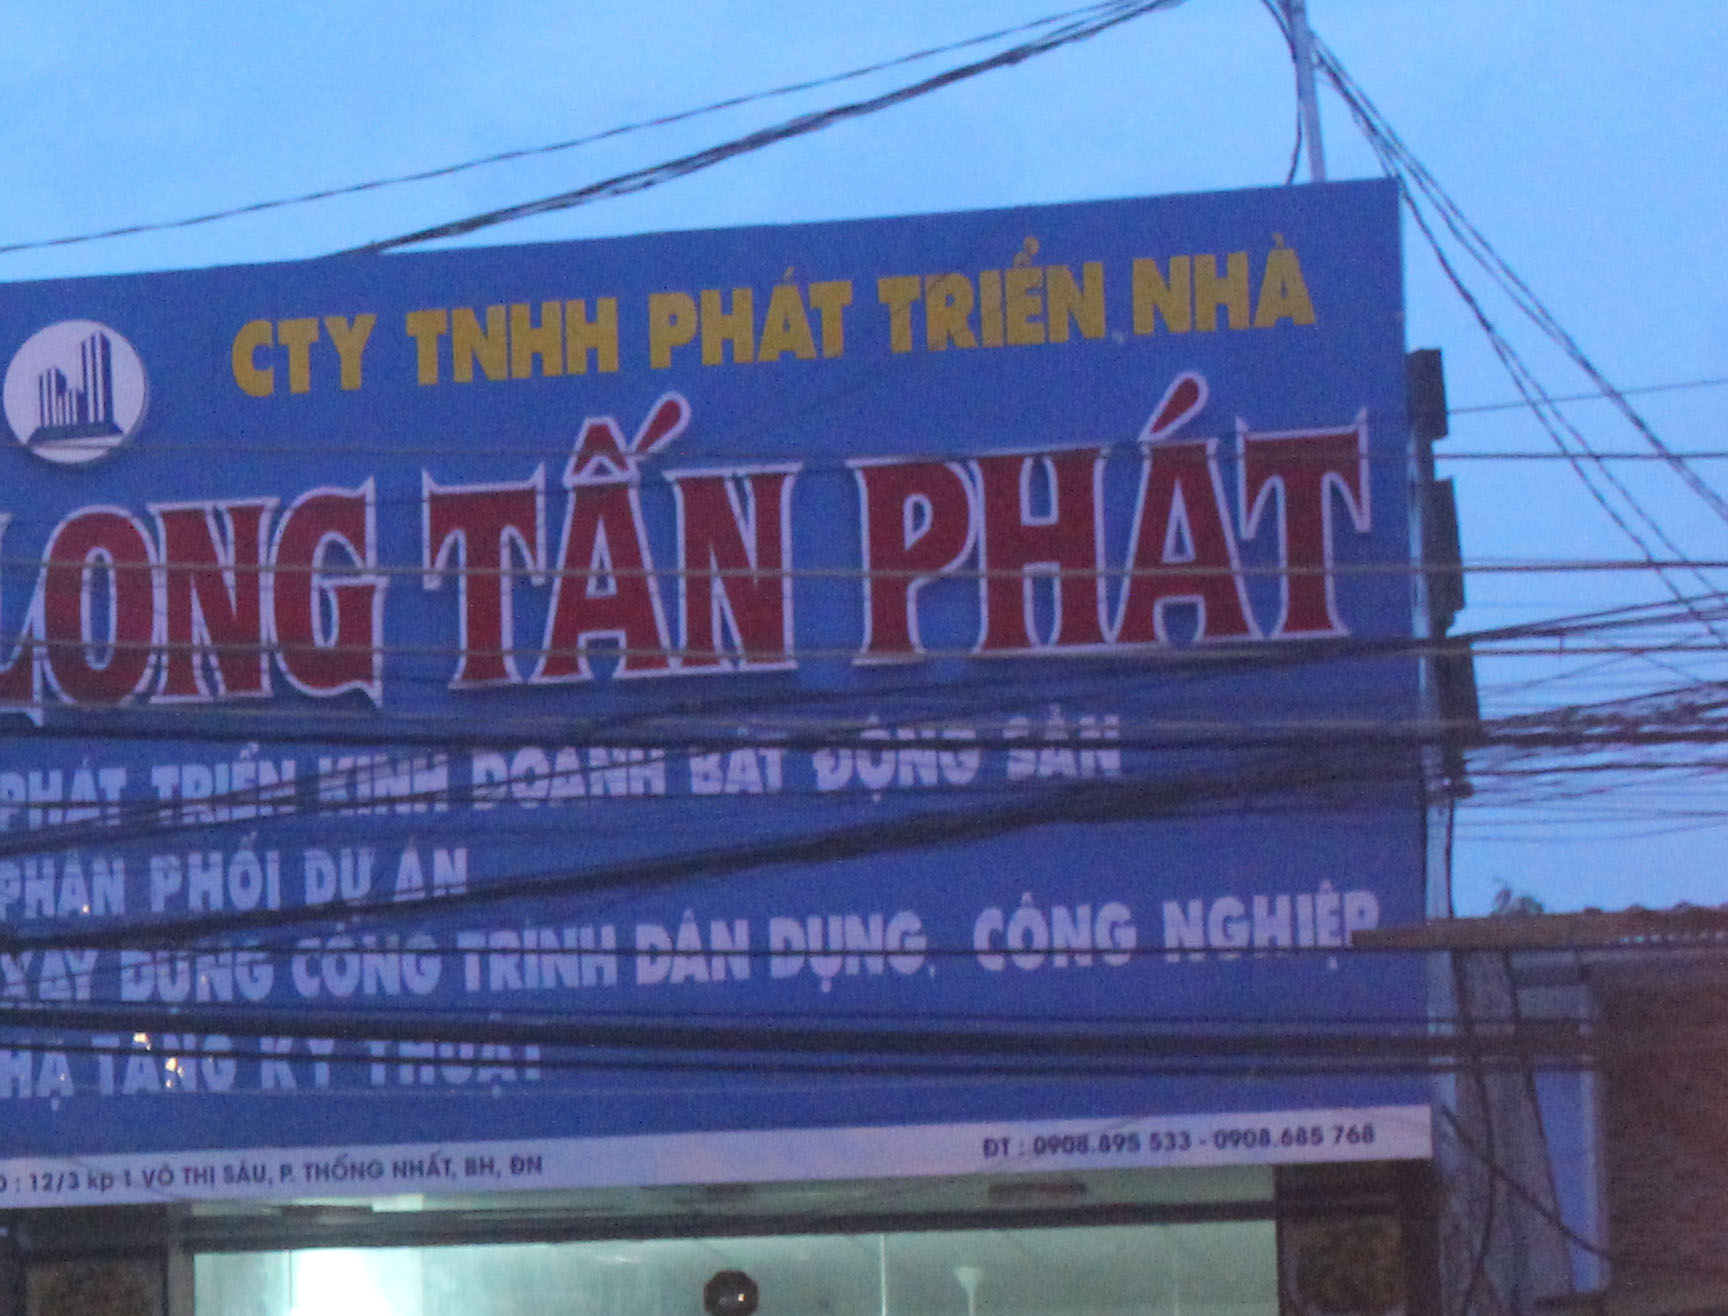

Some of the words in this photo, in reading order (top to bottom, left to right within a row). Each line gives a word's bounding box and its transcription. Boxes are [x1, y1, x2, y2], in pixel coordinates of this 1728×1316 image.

[231, 313, 377, 398] CTY
[405, 296, 620, 386] TNHH
[648, 266, 853, 370] PHÁT
[877, 236, 1107, 354] TRIỂN
[1131, 231, 1318, 336] NHÀ
[423, 391, 802, 692] TẤN
[844, 370, 1372, 670] PHÁT
[634, 909, 751, 986] DÂN
[972, 892, 1138, 972] CÔNG
[1163, 879, 1381, 971] NGHIỆP
[181, 1165, 216, 1190] THỊ
[303, 1154, 385, 1183] THỐNG
